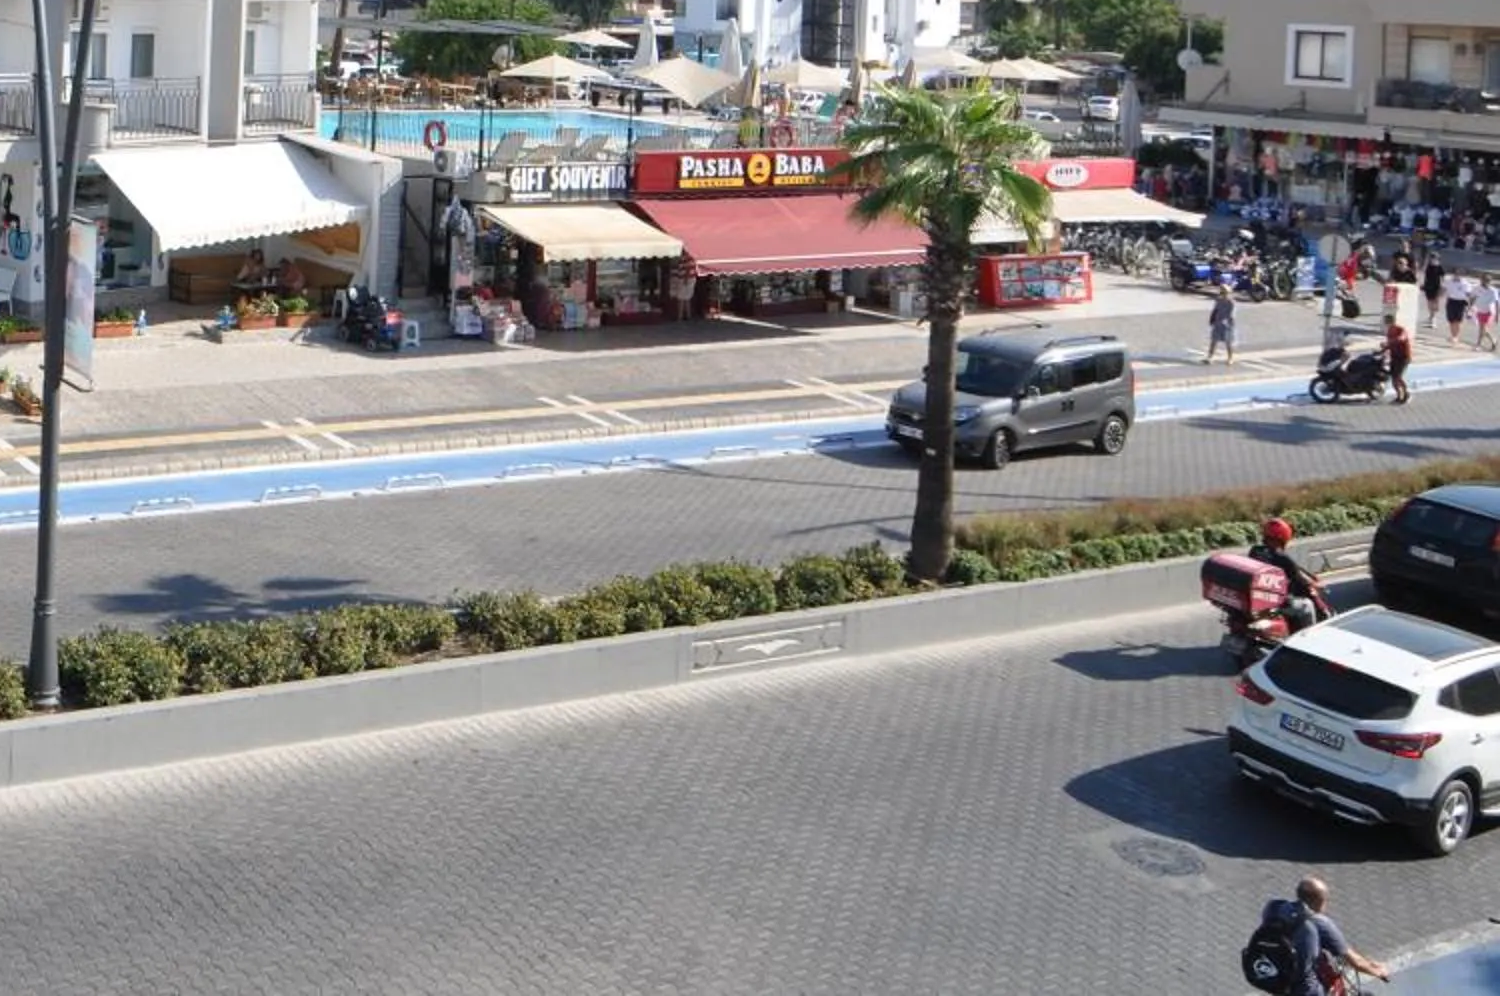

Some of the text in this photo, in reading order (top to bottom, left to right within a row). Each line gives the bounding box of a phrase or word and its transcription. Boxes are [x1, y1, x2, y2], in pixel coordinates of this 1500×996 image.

[510, 165, 627, 192] GIFT SOUVENIR
[680, 153, 825, 178] PASHA BABA
